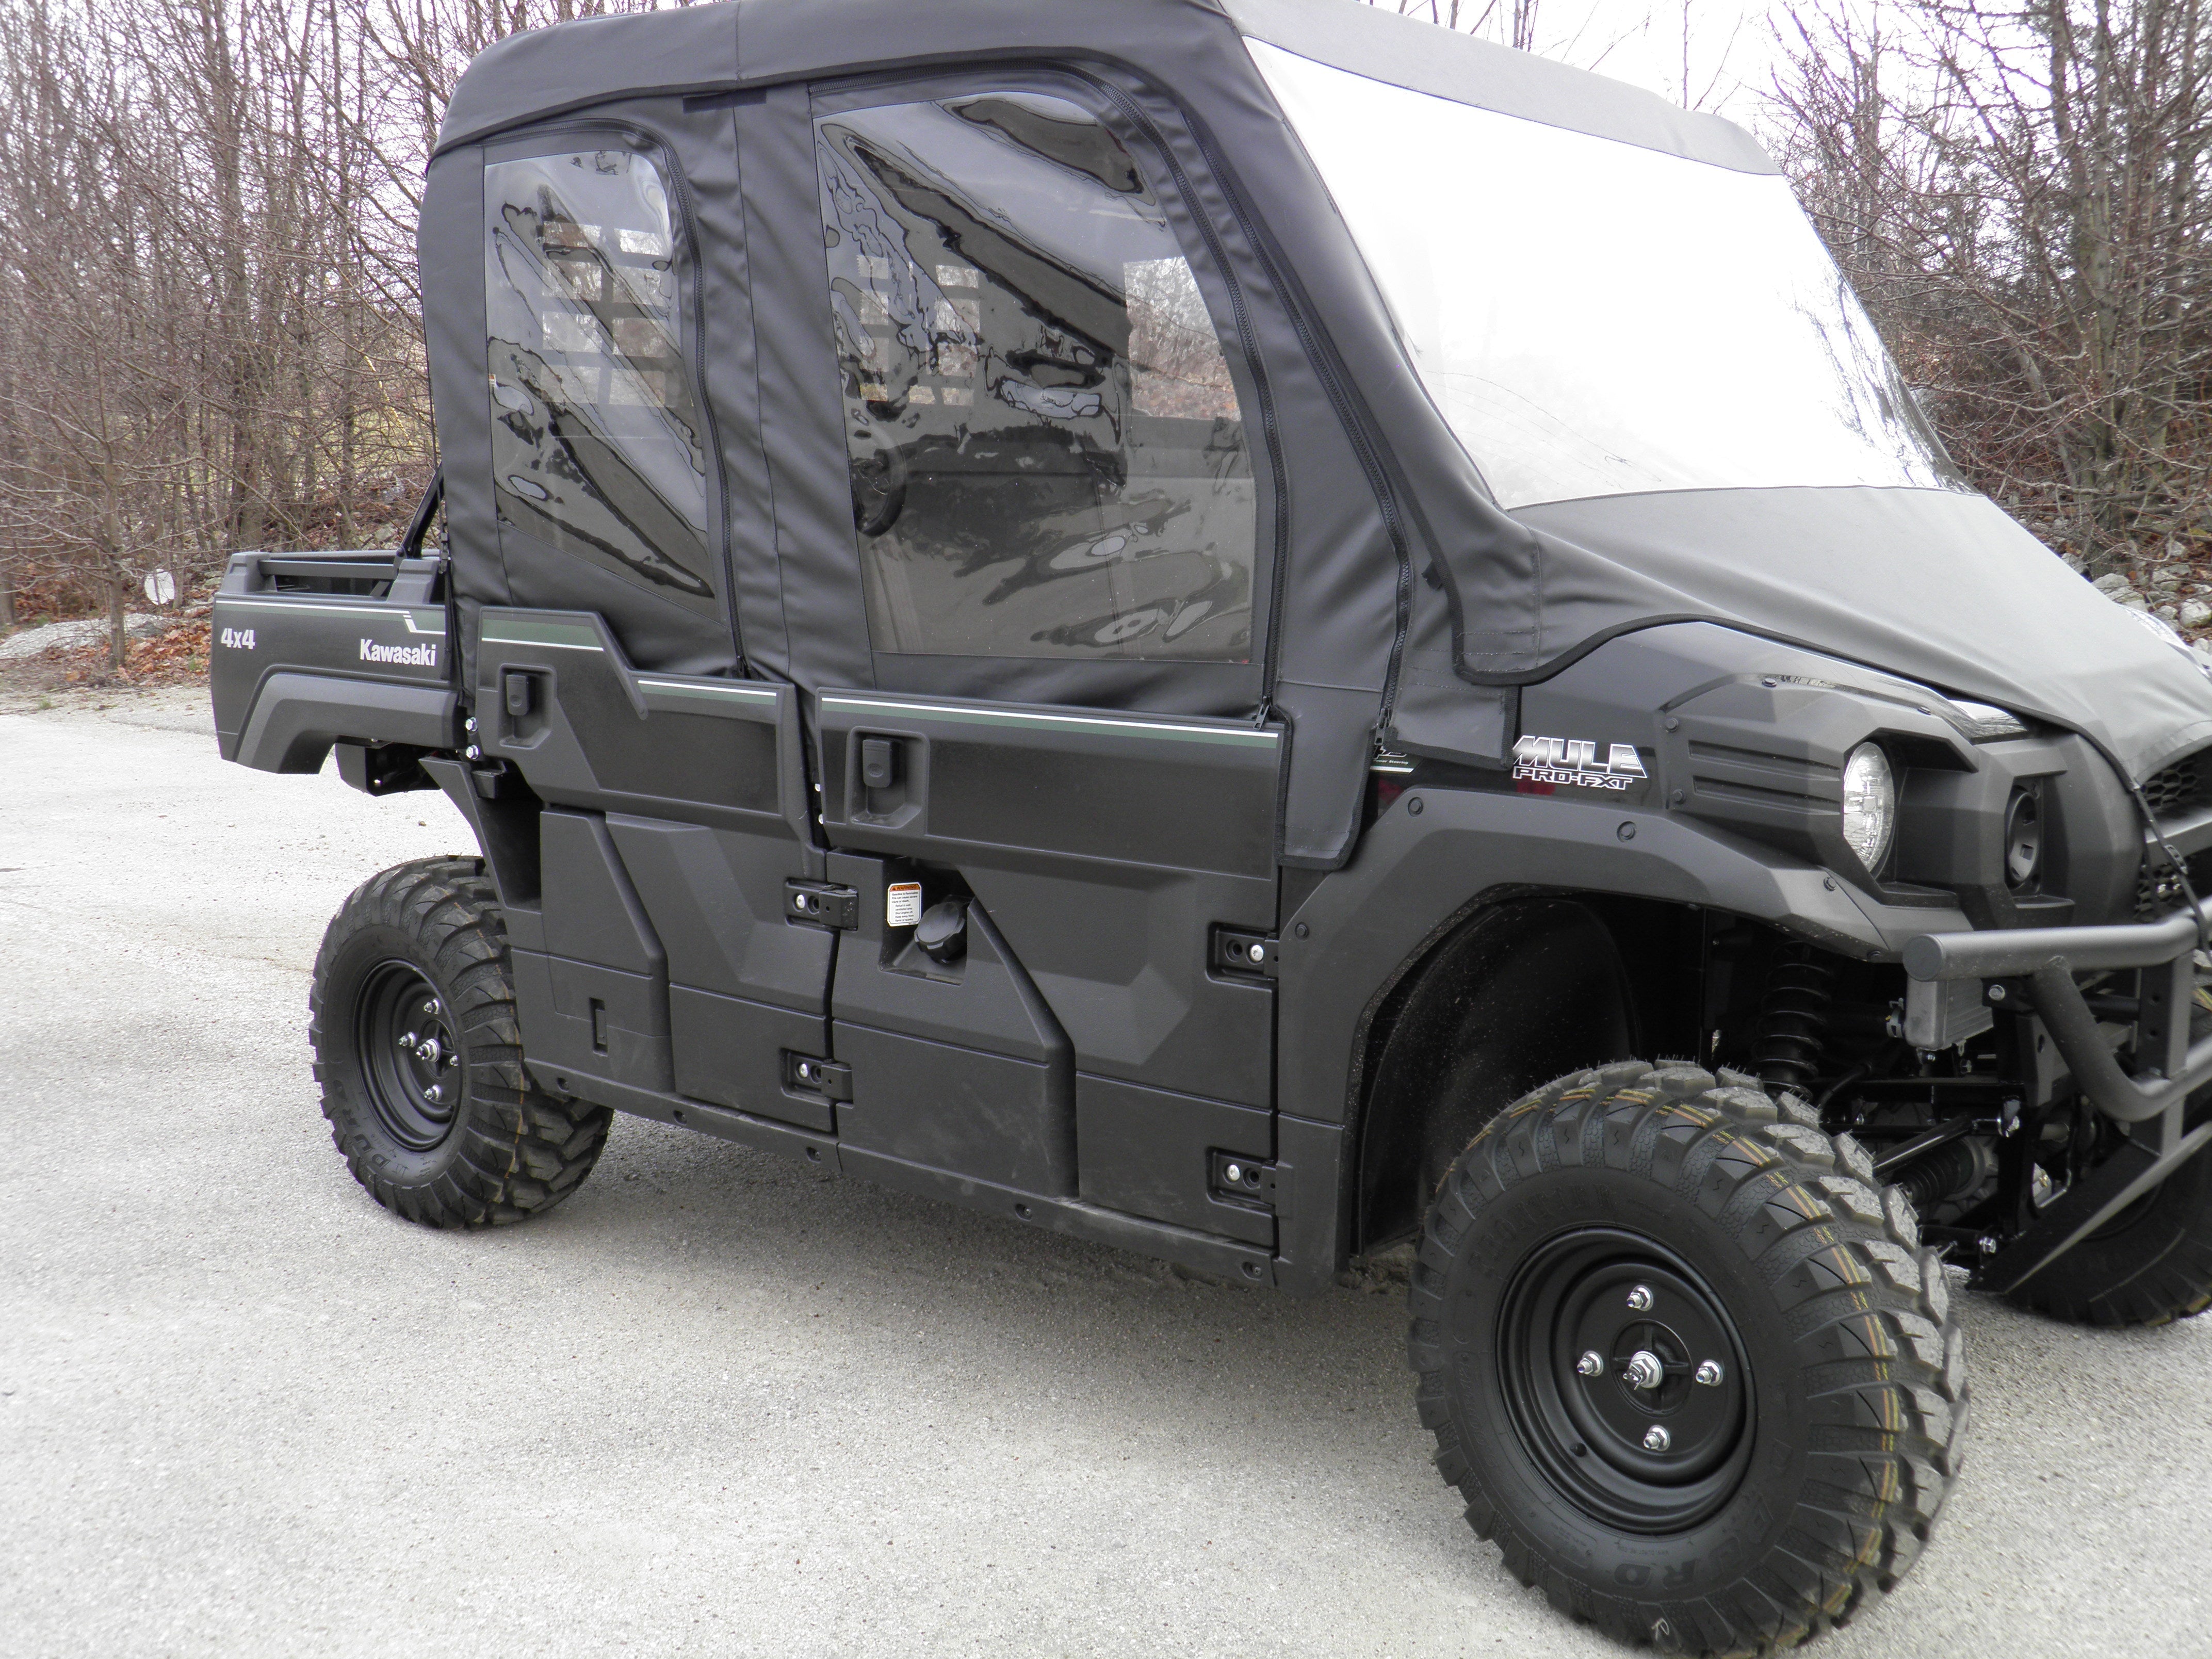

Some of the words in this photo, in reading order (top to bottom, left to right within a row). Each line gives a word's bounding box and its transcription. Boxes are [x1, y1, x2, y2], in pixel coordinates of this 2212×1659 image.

[221, 627, 255, 650] 4x4
[360, 639, 436, 666] Kawasaki
[1512, 735, 1647, 778] MULE
[1512, 766, 1632, 790] PRO-FXT
